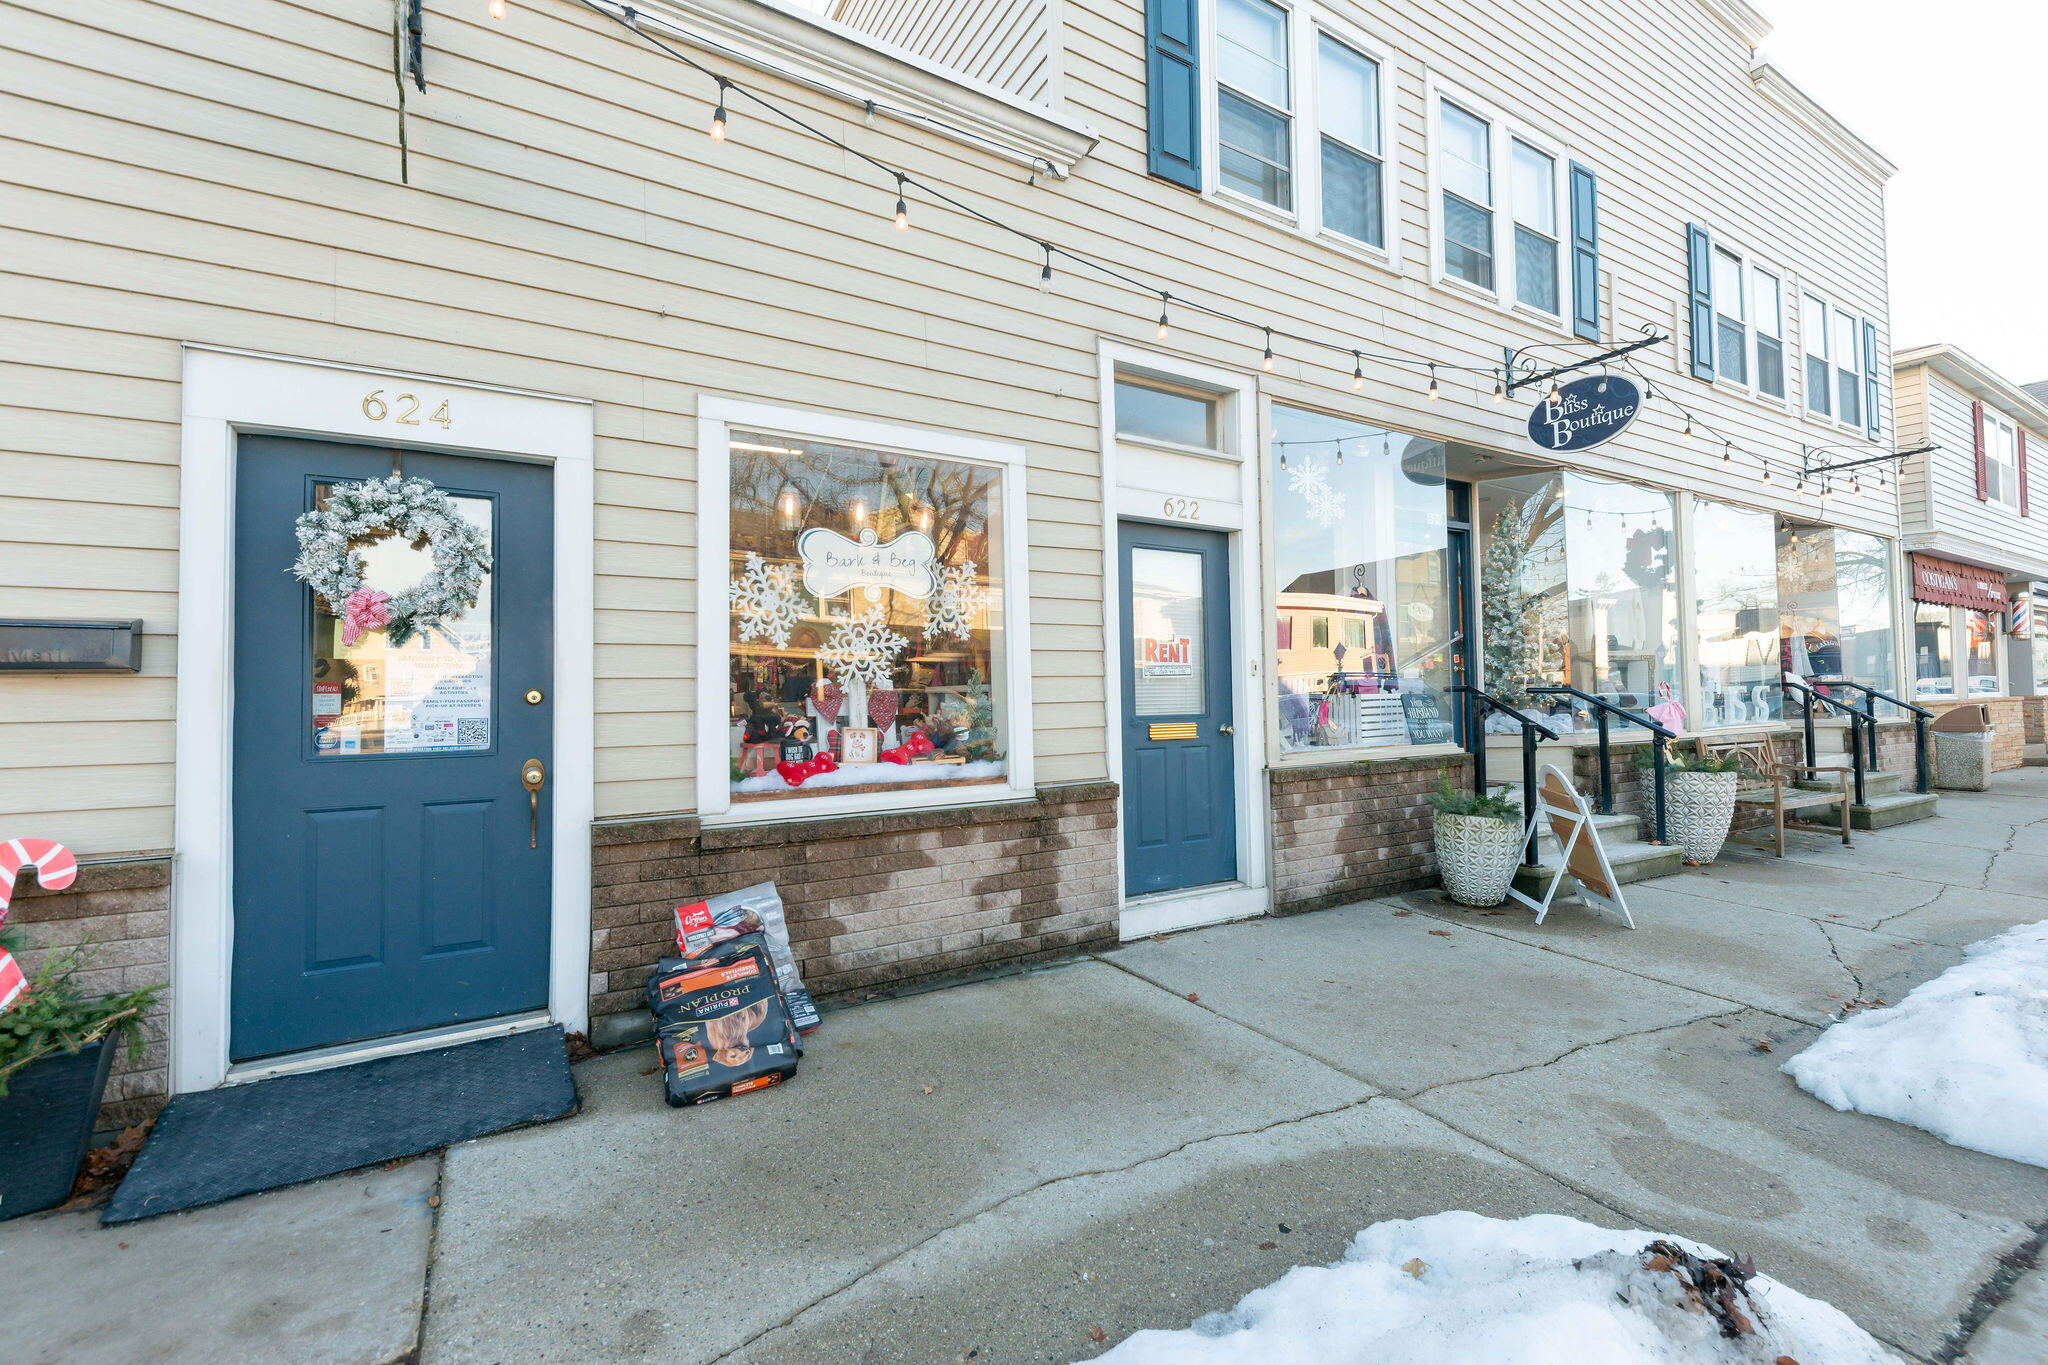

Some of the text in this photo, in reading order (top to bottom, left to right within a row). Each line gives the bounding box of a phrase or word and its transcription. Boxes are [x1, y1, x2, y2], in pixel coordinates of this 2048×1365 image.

[362, 389, 452, 430] 624
[1543, 393, 1589, 425] Bliss
[1550, 403, 1634, 449] Boutique
[1163, 497, 1200, 521] 622
[825, 551, 917, 577] Bark & Beg
[860, 568, 892, 579] Boutique
[1144, 637, 1190, 663] RENT
[680, 984, 751, 1013] PRO PLAN
[698, 1001, 730, 1014] PURINA
